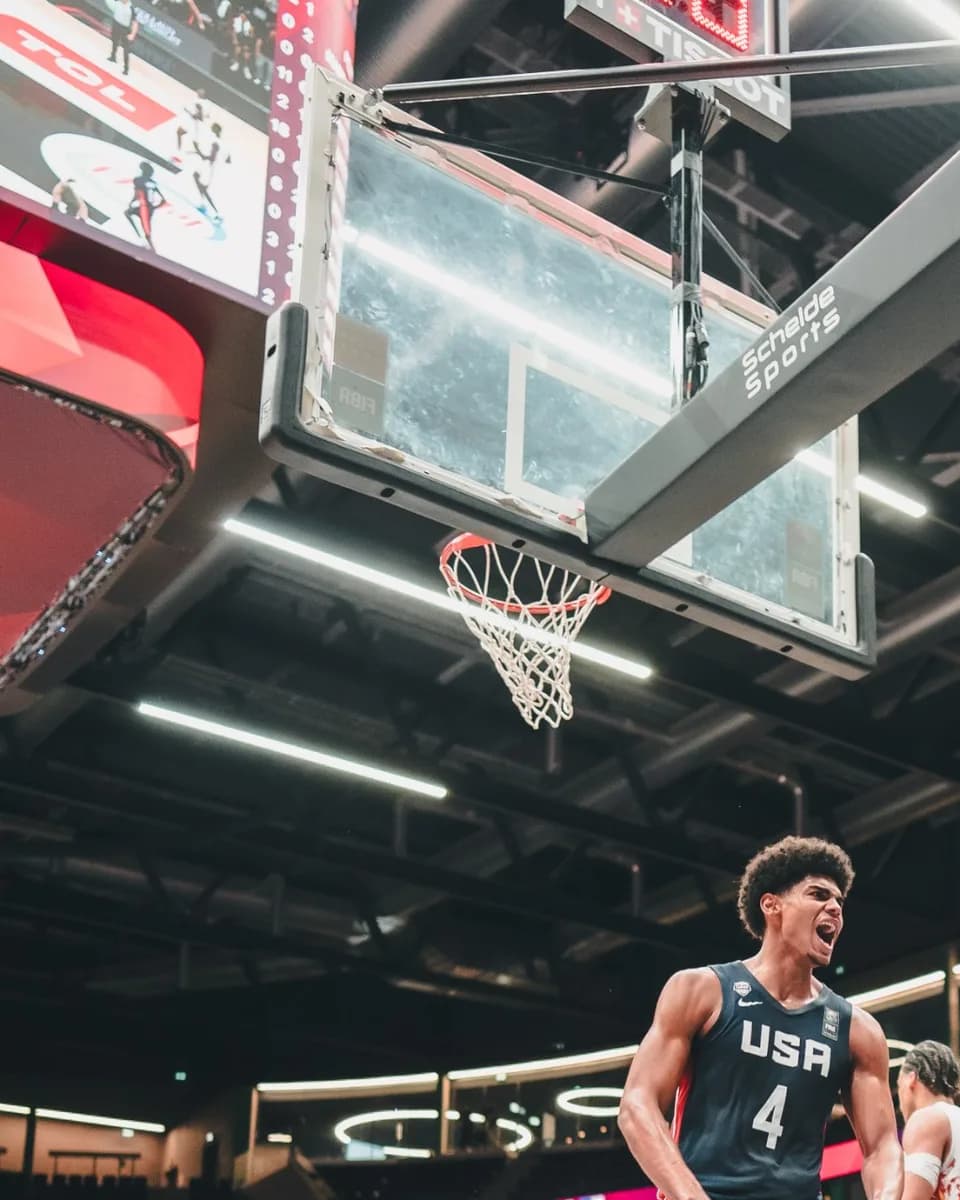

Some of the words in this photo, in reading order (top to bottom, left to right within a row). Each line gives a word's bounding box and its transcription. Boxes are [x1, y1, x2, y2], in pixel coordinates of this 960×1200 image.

[646, 14, 785, 116] TISOT
[741, 1019, 832, 1078] USA
[752, 1084, 788, 1151] 4
